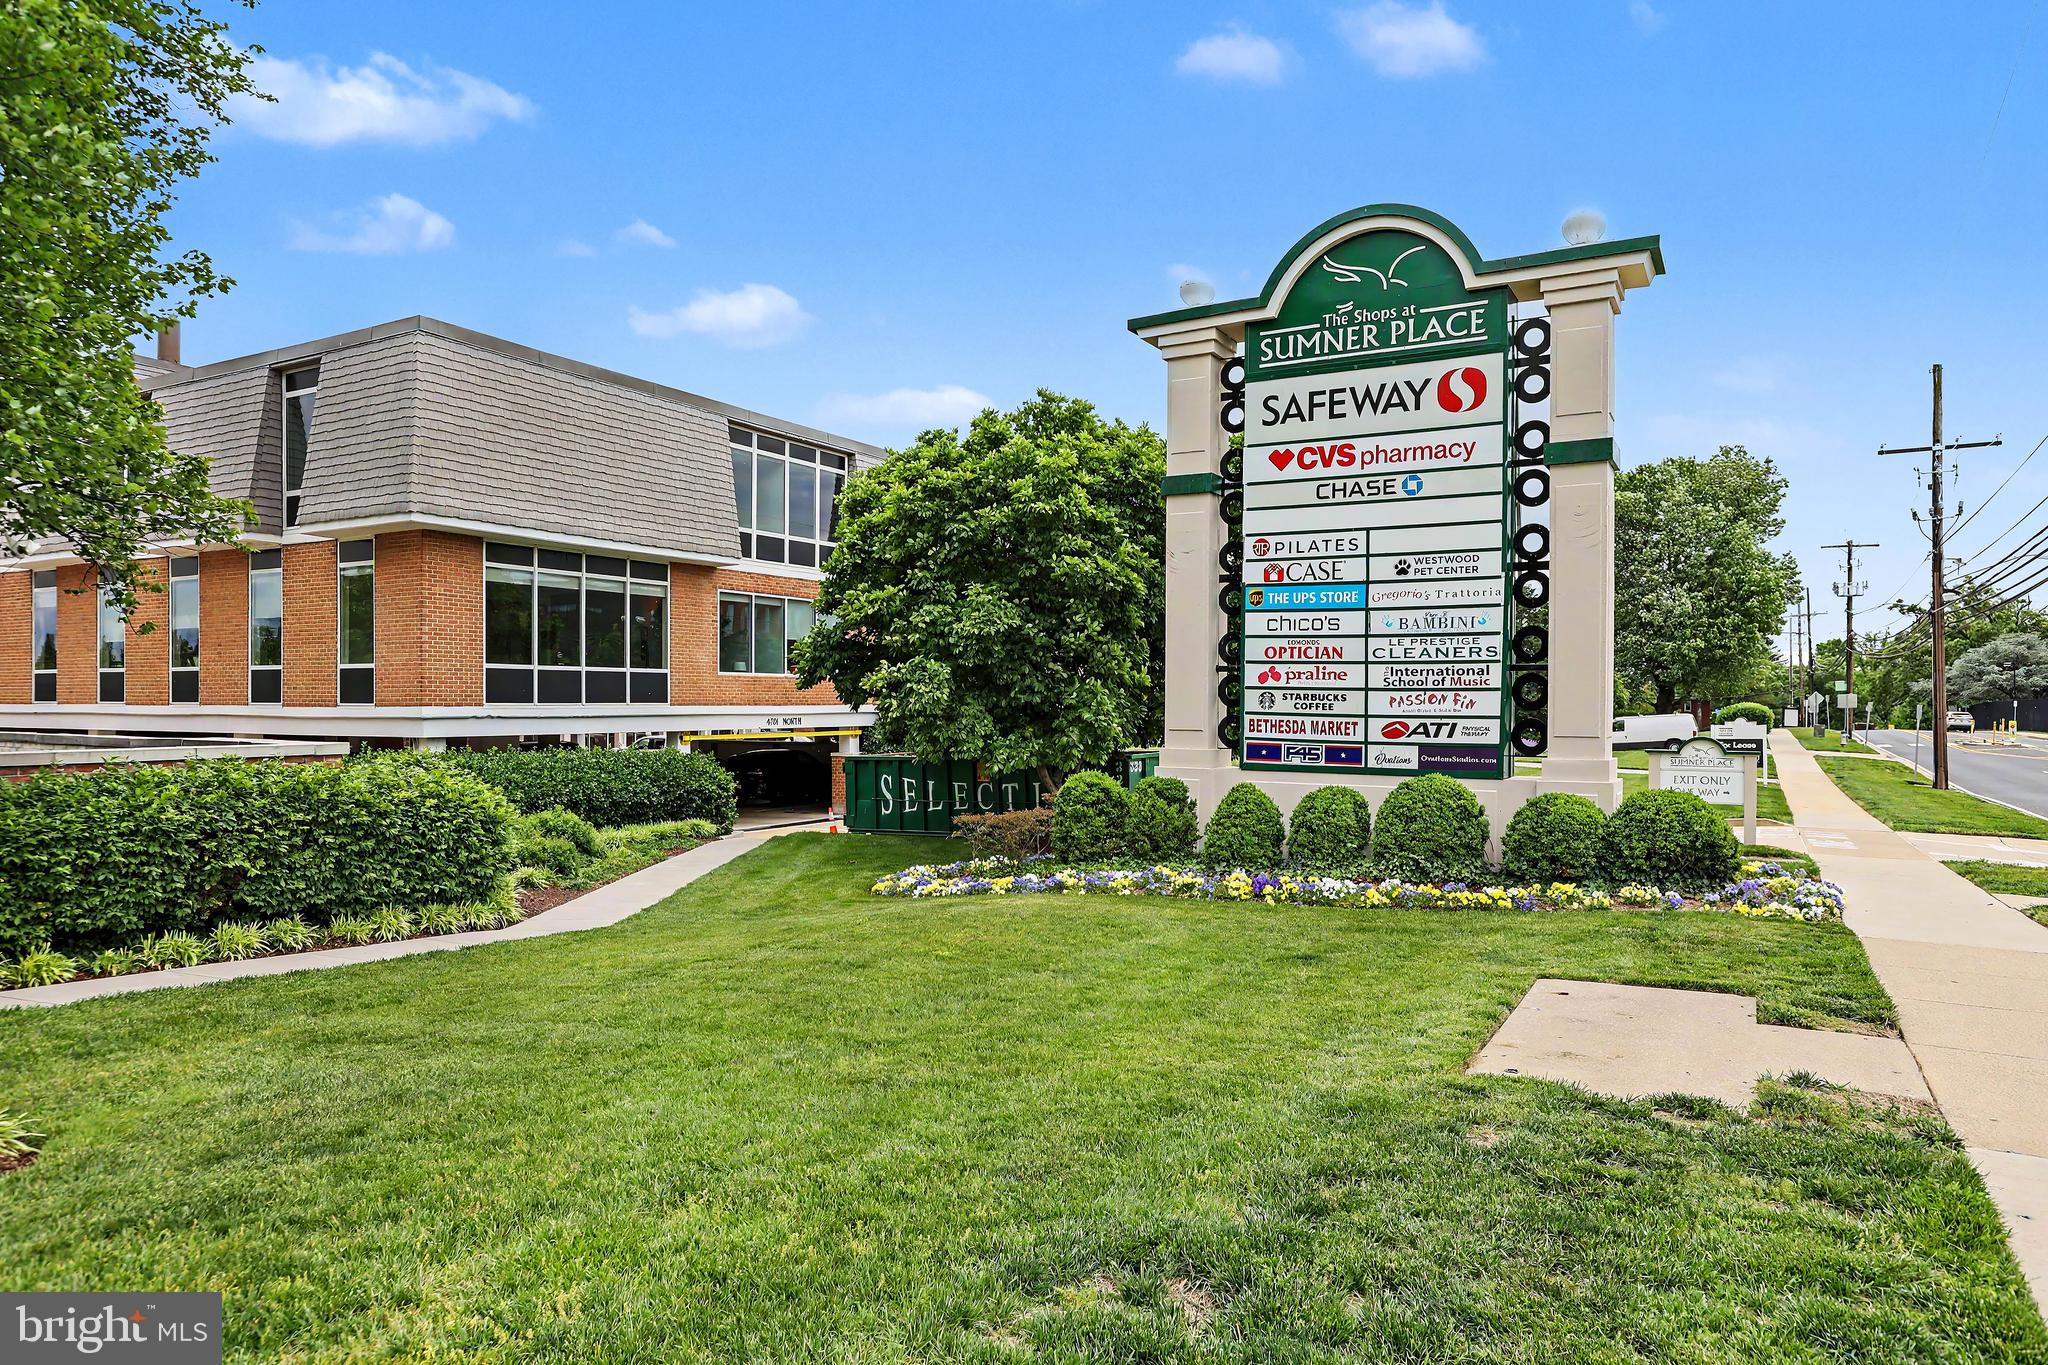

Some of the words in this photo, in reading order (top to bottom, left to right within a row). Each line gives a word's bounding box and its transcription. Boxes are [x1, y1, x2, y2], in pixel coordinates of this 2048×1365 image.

[1323, 314, 1348, 327] The
[1354, 308, 1397, 325] Shops
[1402, 305, 1416, 317] at
[1260, 324, 1380, 362] SUMNER
[1390, 308, 1486, 345] PLACE
[1262, 378, 1432, 426] SAFEWAY
[1297, 443, 1356, 470] CVS
[1360, 441, 1476, 470] pharmacy
[1316, 478, 1397, 500] CHASE
[1275, 538, 1359, 554] PILATES
[1413, 554, 1480, 565] WESTWOOD
[1286, 561, 1344, 581] CASE
[1414, 567, 1433, 576] PET
[1436, 565, 1479, 576] CENTER
[1268, 592, 1289, 604] THE
[1293, 591, 1316, 604] UPS
[1320, 590, 1358, 603] STORE
[1372, 588, 1431, 602] Gregorio's
[1435, 587, 1501, 599] Trattoria
[1398, 616, 1476, 630] BAMBINI
[1389, 638, 1405, 646] LE
[1410, 637, 1481, 646] PRESTIGE
[1264, 646, 1343, 659] OPTICIAN
[1372, 646, 1498, 659] CLEANERS
[1285, 665, 1348, 684] praline
[1390, 665, 1490, 677] International
[1383, 677, 1428, 687] School
[1430, 677, 1447, 687] of
[1450, 677, 1490, 686] Music
[1282, 693, 1347, 702] STARBUCKS
[1294, 702, 1334, 711] COFFEE
[782, 717, 802, 726] NORTH
[1248, 718, 1307, 735] BETHESDA
[1310, 719, 1358, 736] MARKET
[1405, 722, 1458, 738] ATI
[1285, 746, 1322, 762] F45
[1708, 759, 1734, 767] PLACE
[1673, 776, 1697, 785] EXIT
[1700, 776, 1731, 786] ONLY
[1698, 788, 1720, 797] WAY
